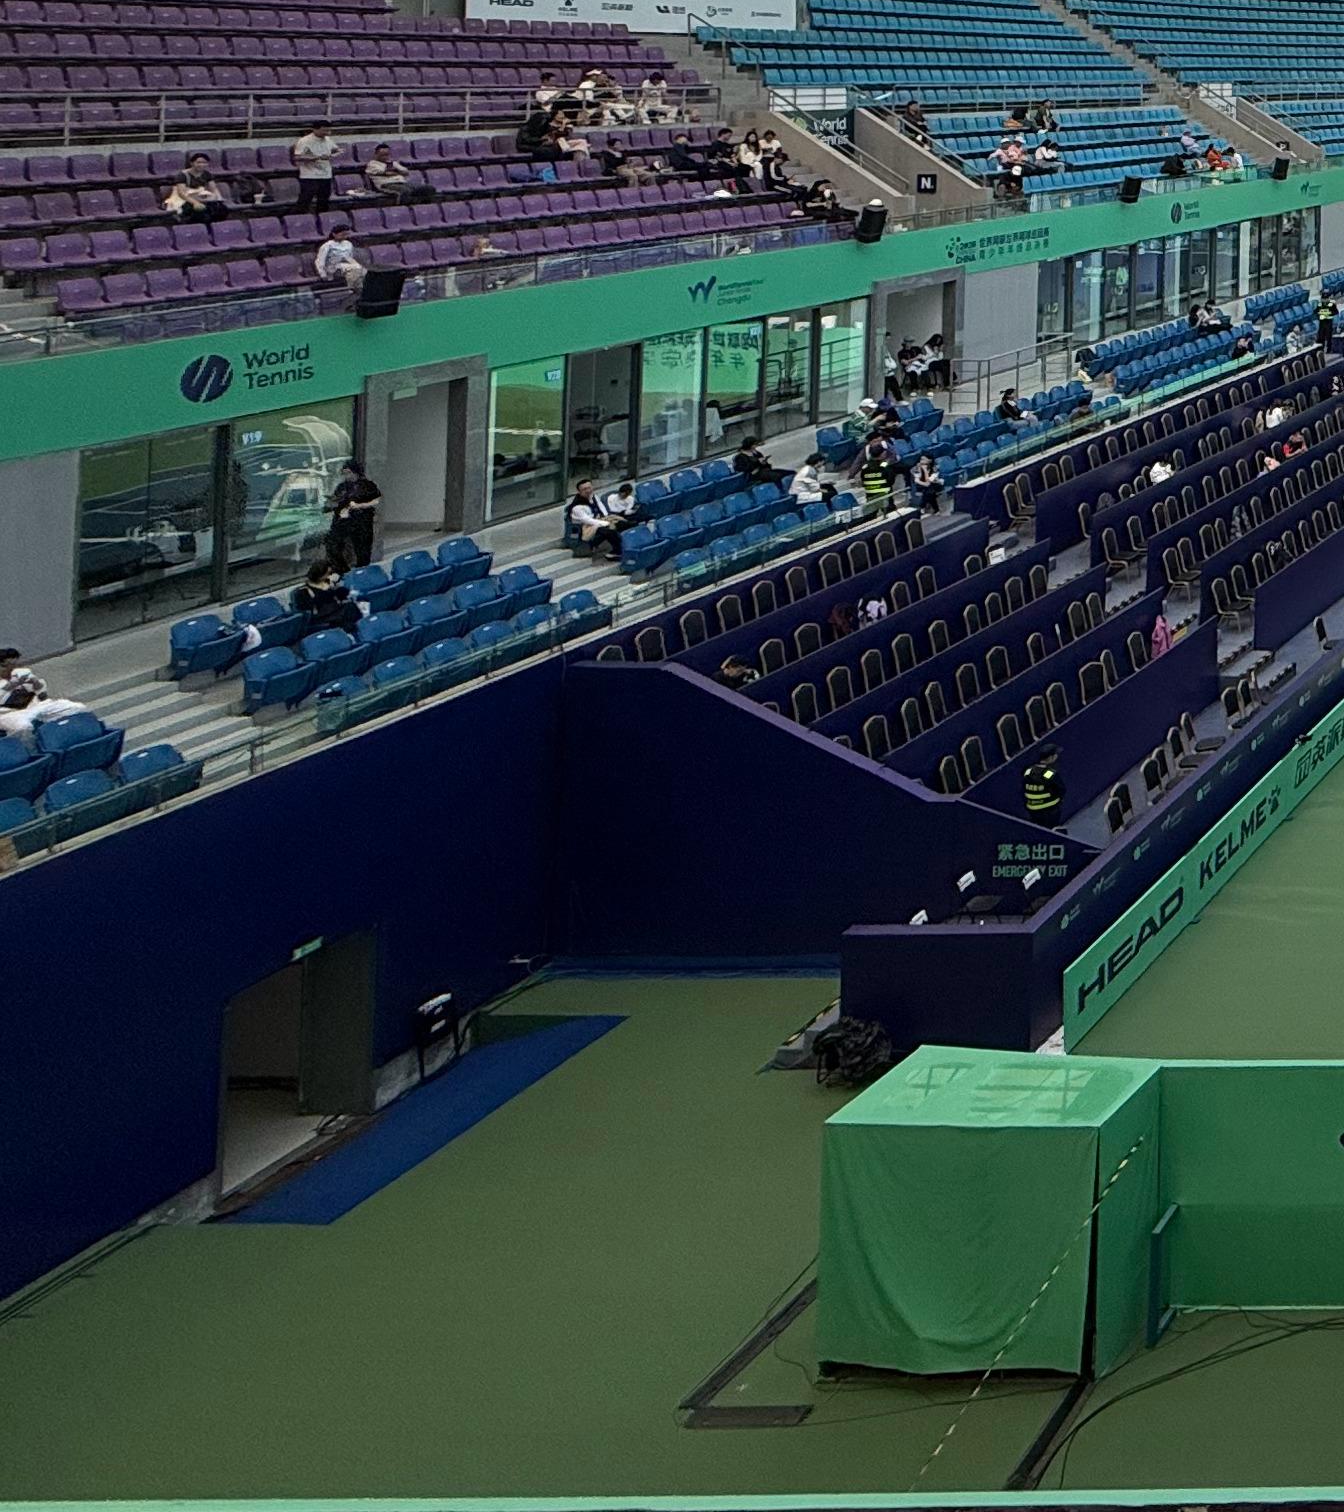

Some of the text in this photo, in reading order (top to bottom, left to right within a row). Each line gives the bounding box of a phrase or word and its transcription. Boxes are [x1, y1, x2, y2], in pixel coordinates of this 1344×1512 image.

[814, 116, 847, 132] World
[242, 343, 310, 370] World
[242, 362, 315, 390] Tennis
[997, 843, 1065, 861] 紧急出口
[1199, 797, 1268, 890] KELME
[1048, 865, 1068, 878] EXIT
[1077, 886, 1184, 1016] HEAD
